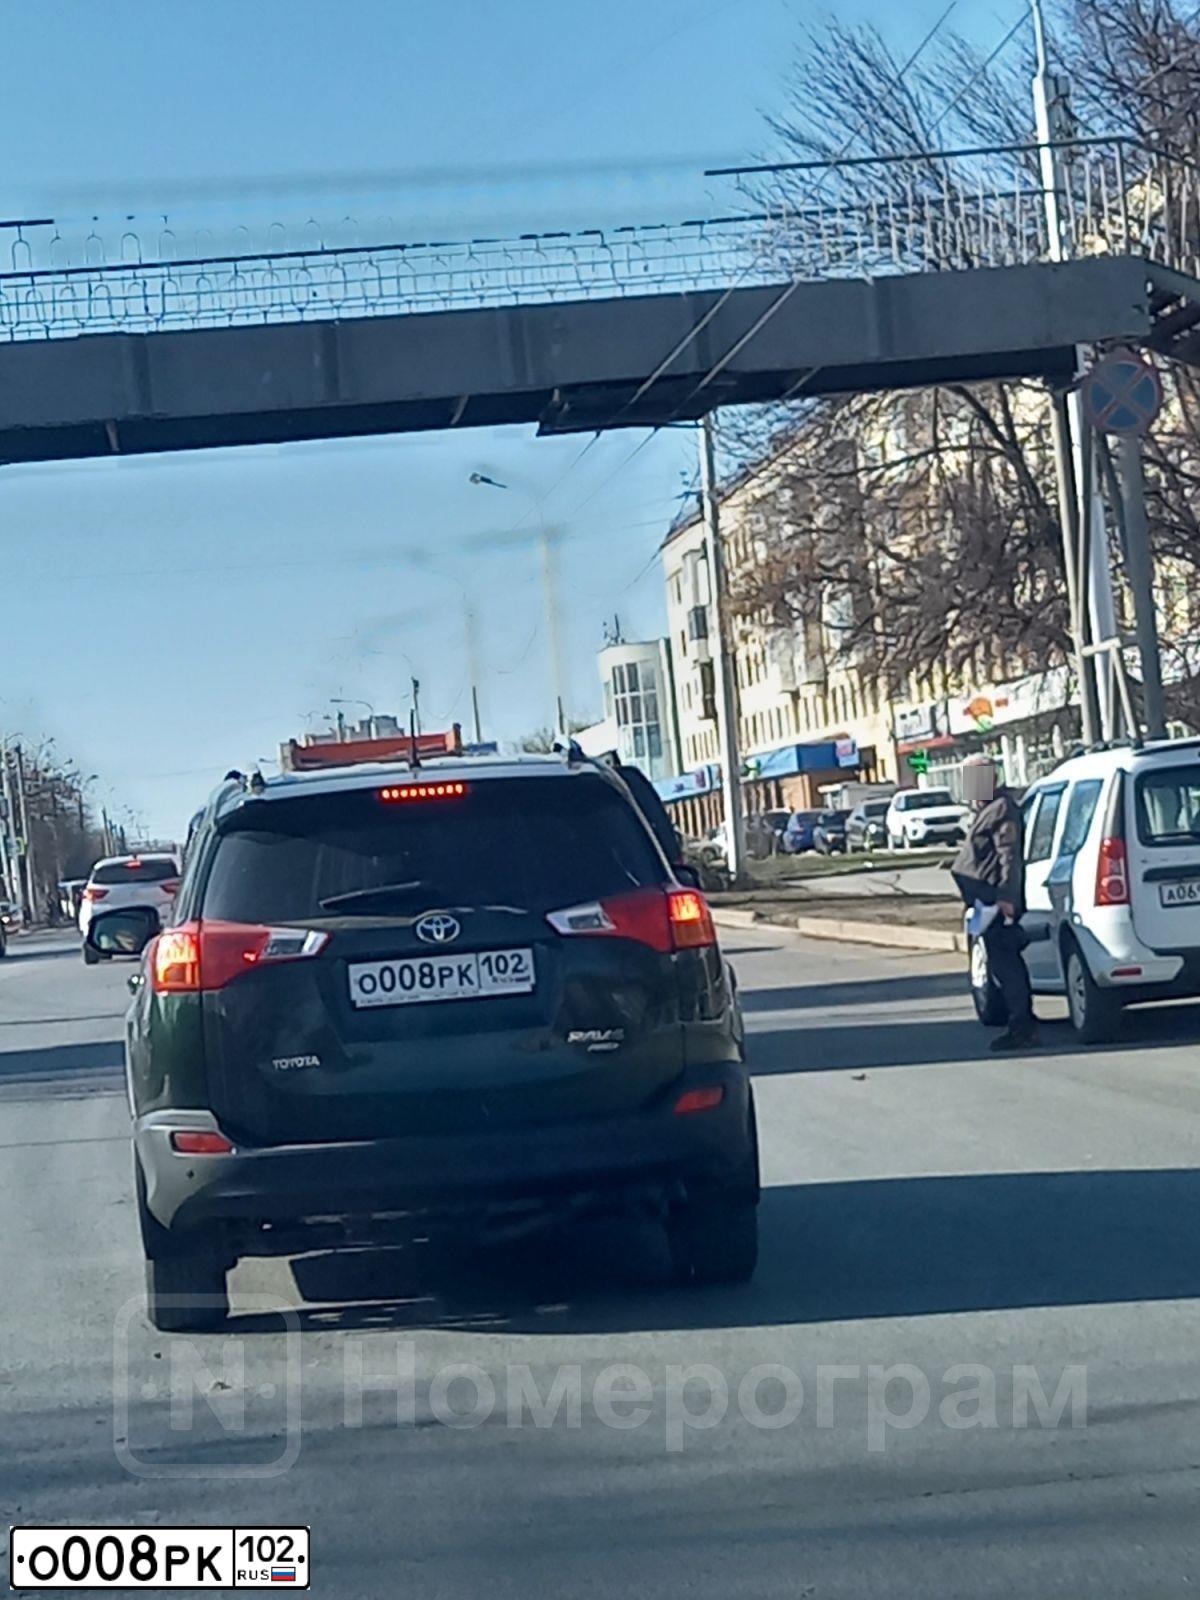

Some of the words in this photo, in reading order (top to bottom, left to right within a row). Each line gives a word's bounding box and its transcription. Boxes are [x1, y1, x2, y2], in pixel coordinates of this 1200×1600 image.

[1167, 884, 1200, 900] А06
[359, 962, 475, 995] О008РК
[481, 953, 524, 977] 102
[272, 1055, 320, 1070] TOYOTA
